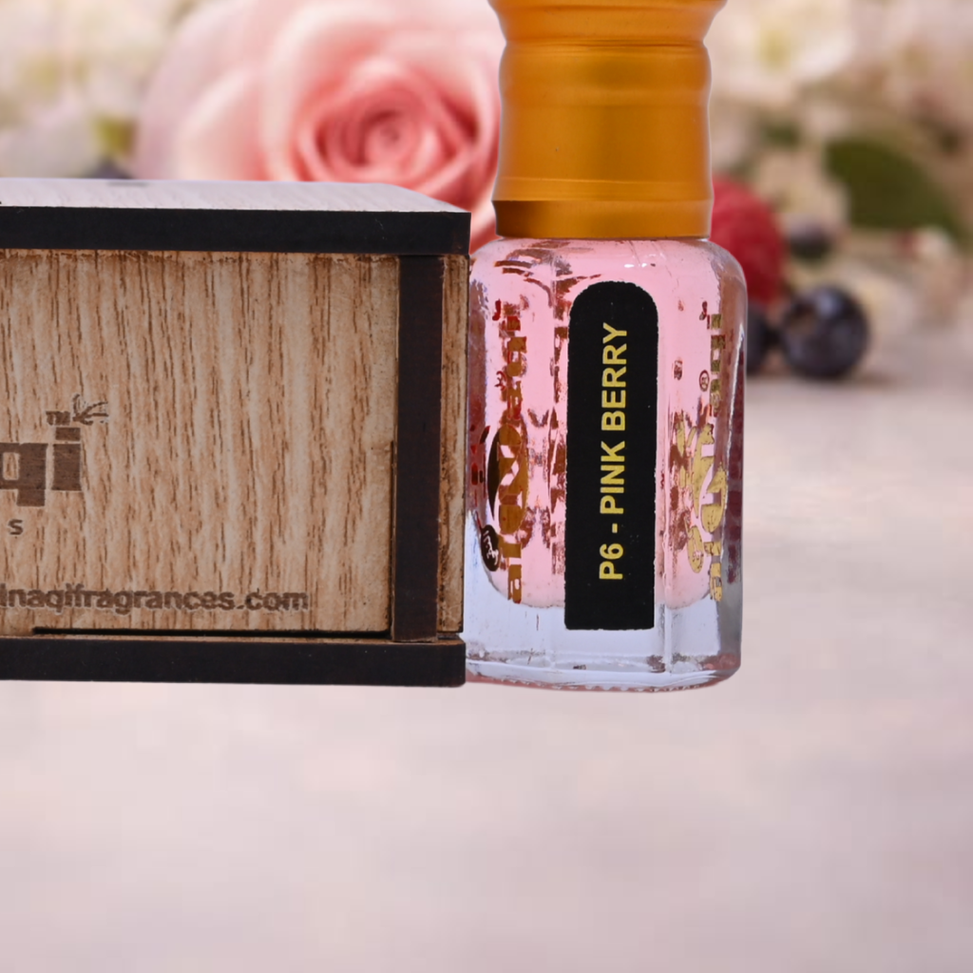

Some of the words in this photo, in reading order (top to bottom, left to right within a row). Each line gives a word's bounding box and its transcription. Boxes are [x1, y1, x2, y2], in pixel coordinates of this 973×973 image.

[600, 322, 628, 431] BERRY
[599, 440, 626, 515] PINK
[598, 543, 624, 580] P6
